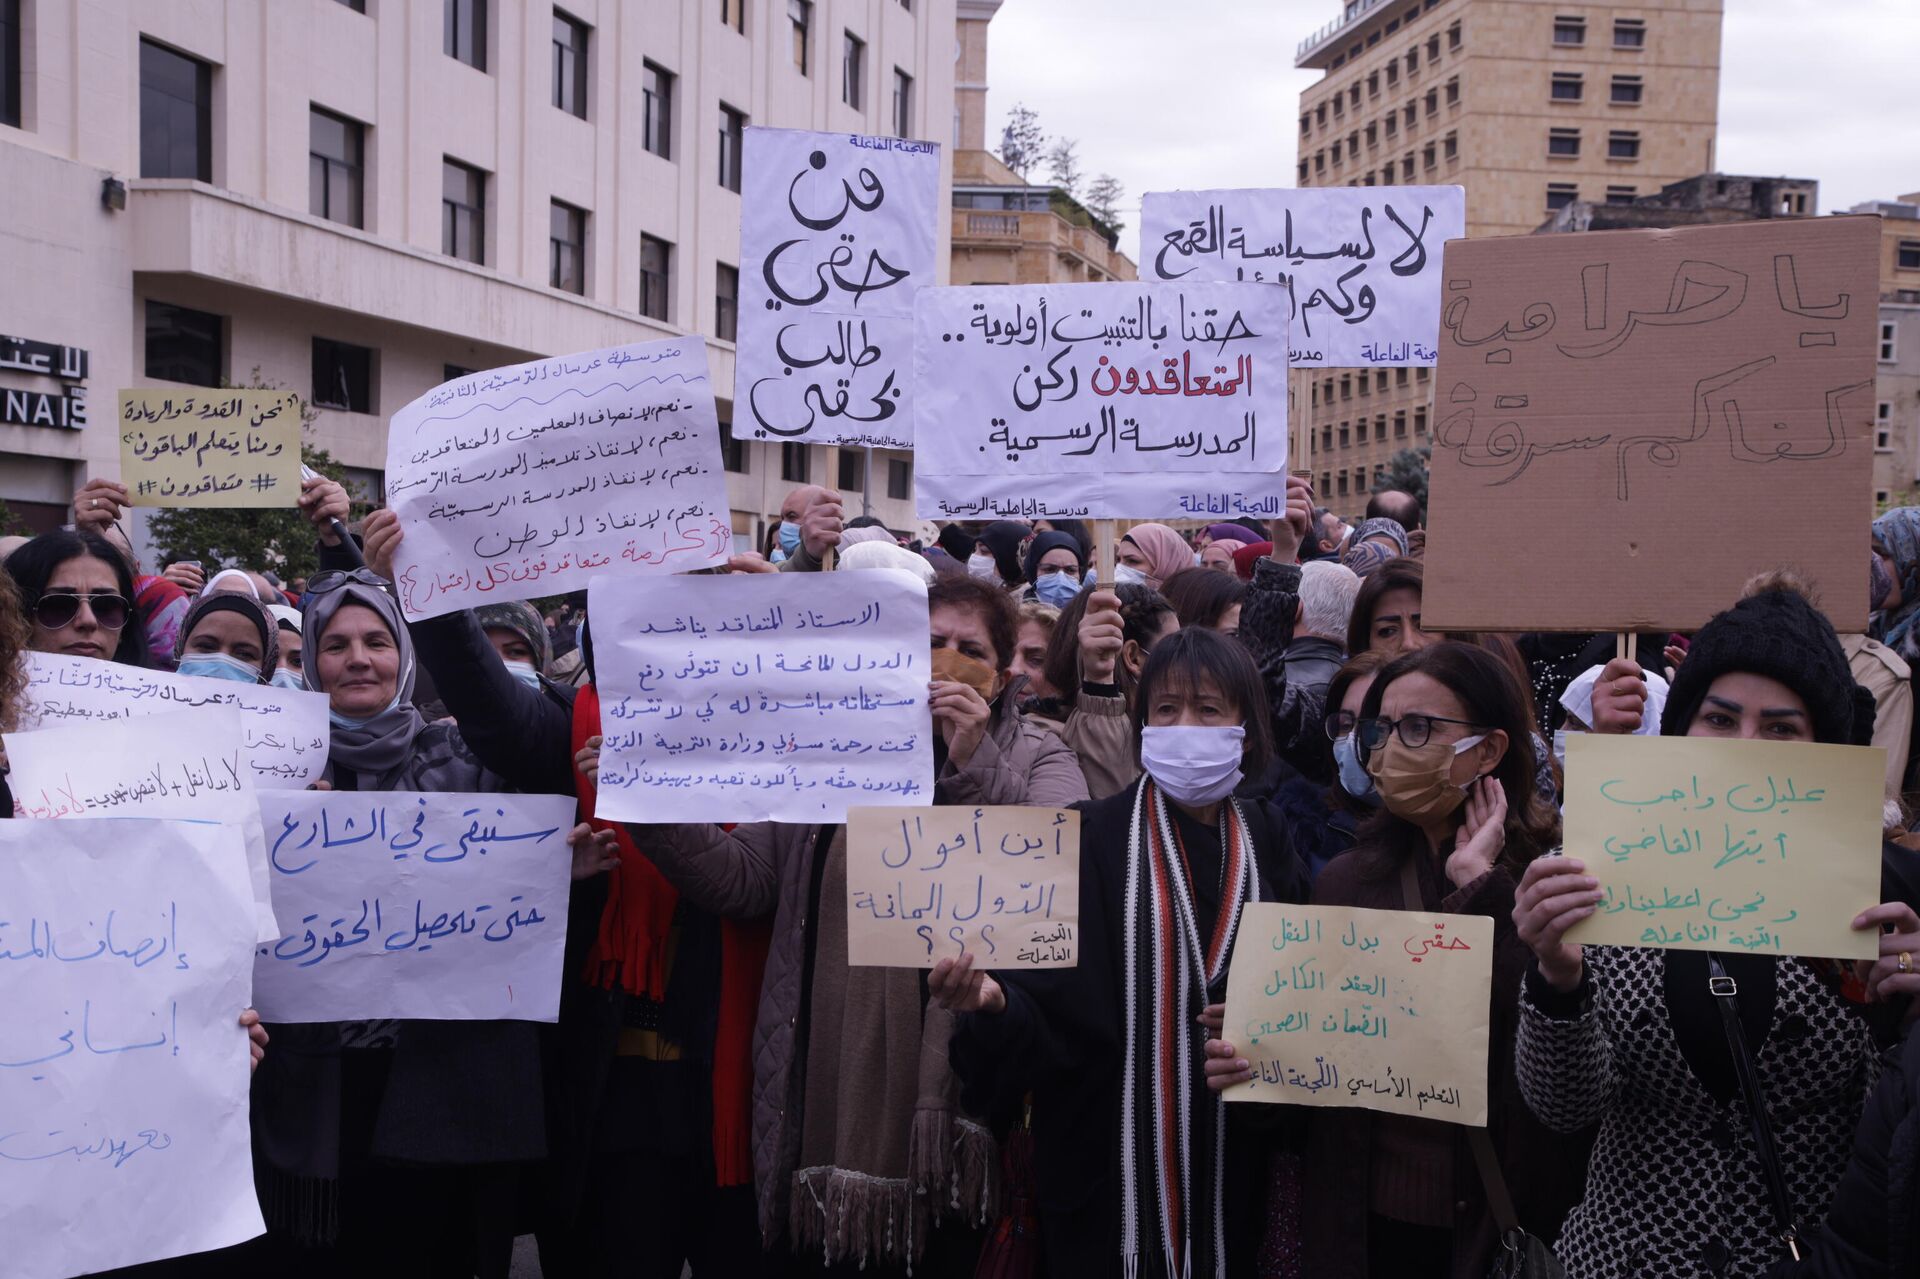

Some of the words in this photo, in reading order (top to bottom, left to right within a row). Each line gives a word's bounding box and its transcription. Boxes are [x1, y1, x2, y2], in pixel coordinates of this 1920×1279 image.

[850, 134, 892, 151] الفاعلة
[894, 139, 934, 157] اللجنة
[1155, 204, 1224, 280] القمع
[1227, 207, 1375, 266] لسياسة
[1384, 204, 1434, 276] لا
[762, 233, 911, 311] حقي
[1774, 255, 1850, 347] يا
[1051, 295, 1167, 349] بالتثبيت
[1180, 294, 1263, 357] حقنا
[608, 348, 681, 369] متوسطة
[776, 320, 882, 378] طالب
[1361, 342, 1410, 362] الفاعلة
[552, 359, 601, 377] عرسال
[1013, 344, 1078, 412] ركن
[1091, 349, 1251, 396] المتعاقدون
[123, 399, 181, 423] والريادة
[184, 398, 243, 419] القدوة
[750, 369, 902, 438] بحقي
[506, 411, 585, 441] المعلمين
[1119, 411, 1257, 461] المدرسة
[1435, 382, 1611, 487] سرقة
[196, 430, 241, 468] يتعلم
[410, 427, 500, 464] المتعاقدين
[451, 452, 527, 484] المدرسة
[522, 476, 596, 504] المدرسة
[1180, 493, 1229, 514] الفاعلة
[1233, 493, 1279, 516] اللجنة
[938, 497, 989, 516] الرسمية
[1038, 503, 1089, 516] مدرسة
[473, 514, 585, 558] الوطن
[475, 562, 511, 591] كل
[511, 554, 547, 581] فوق
[550, 552, 610, 574] متعاقد
[423, 568, 471, 603] اعتبار
[640, 616, 707, 638] يناشد
[715, 605, 784, 632] المتعاقد
[795, 601, 880, 630] الاستاذ
[638, 664, 664, 691] دفع
[775, 653, 834, 672] المانحة
[843, 652, 912, 672] الدول
[160, 685, 222, 706] عرسال
[696, 693, 718, 722] كي
[729, 695, 750, 714] له
[605, 730, 643, 752] الذين
[655, 733, 711, 755] التربية
[719, 732, 765, 754] وزارة
[830, 738, 872, 753] رحمة
[878, 734, 917, 751] تحت
[151, 762, 168, 796] لا
[222, 749, 241, 791] لا
[708, 772, 744, 789] تعبه
[1600, 776, 1714, 813] واجب
[1726, 776, 1825, 813] عليك
[272, 807, 386, 875] الشارع
[390, 797, 426, 860] في
[424, 808, 560, 863] سنبقى
[881, 808, 984, 870] أموال
[1000, 812, 1067, 860] أين
[1604, 824, 1701, 862] القاضي
[852, 882, 943, 919] المانحة
[52, 901, 189, 969] إنصاف
[1272, 918, 1320, 950] النقل
[1342, 921, 1379, 954] بدل
[1265, 957, 1324, 996] الكامل
[1246, 1011, 1309, 1044] الصحي
[1347, 1066, 1412, 1098] الأساسي
